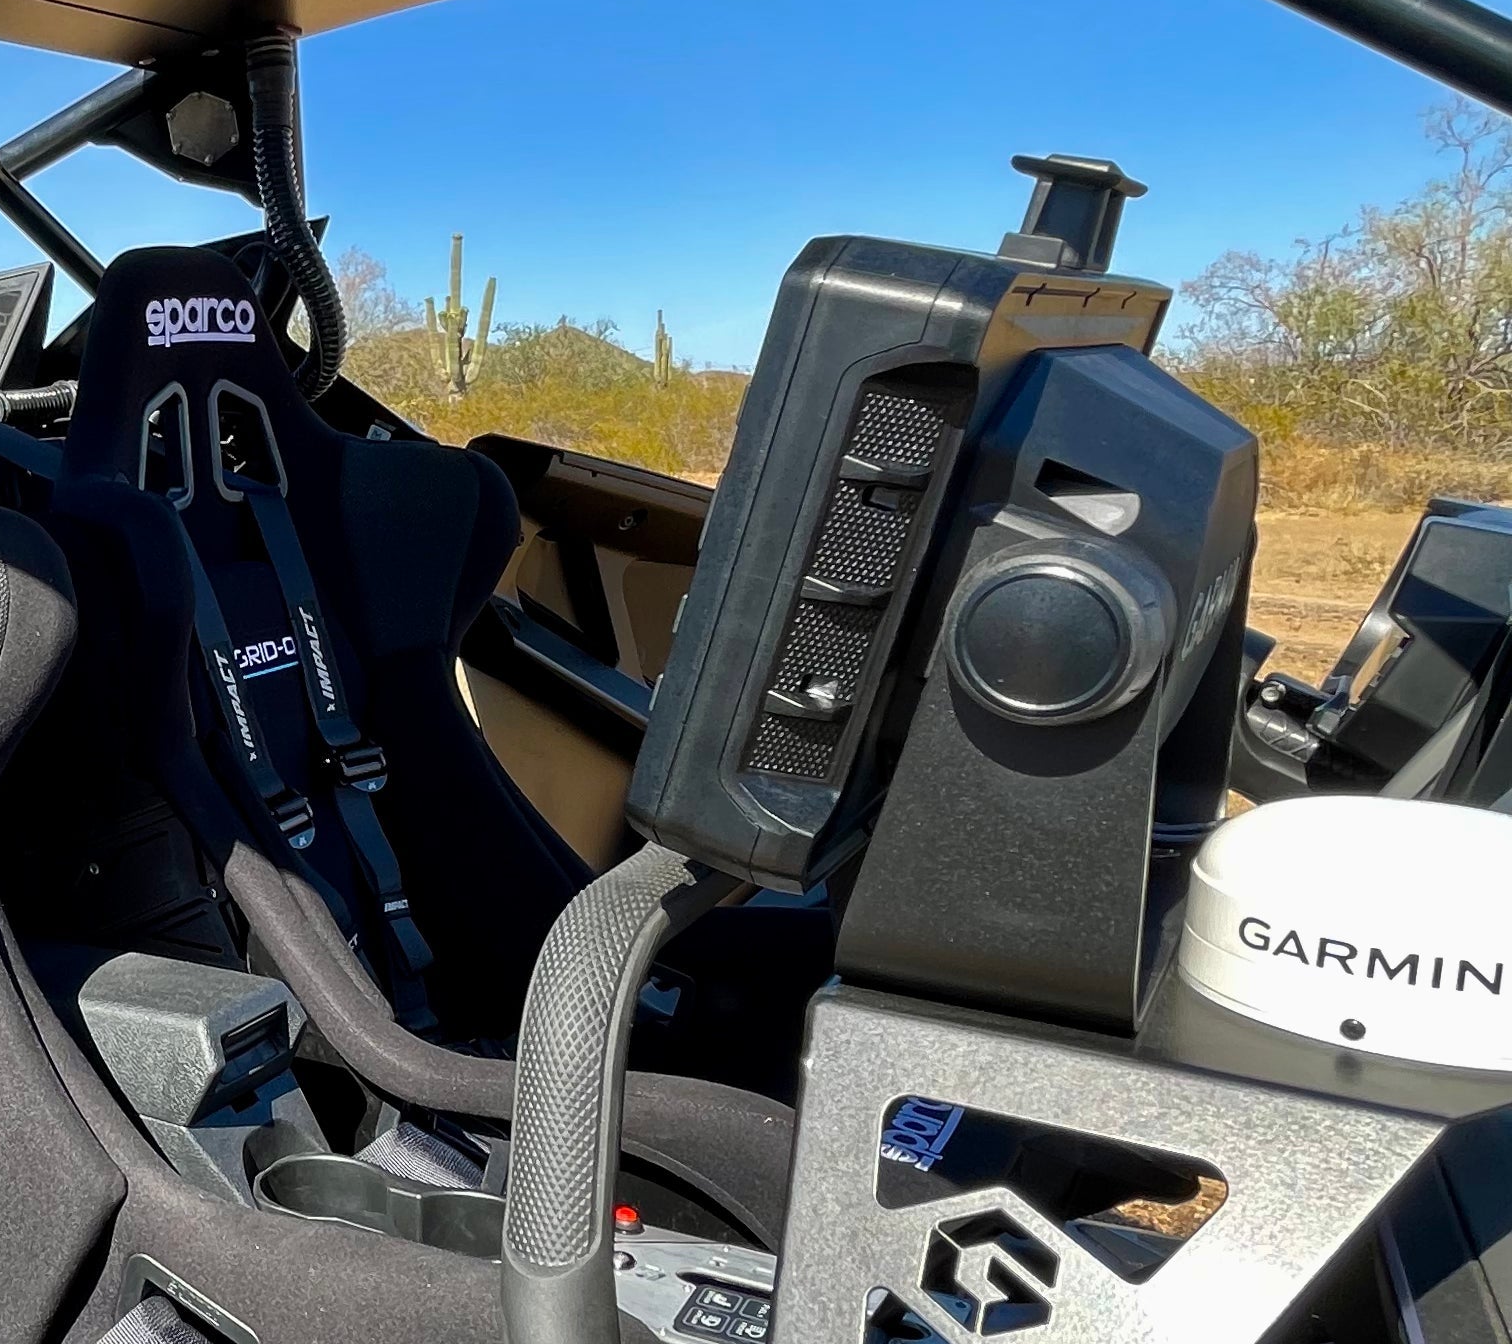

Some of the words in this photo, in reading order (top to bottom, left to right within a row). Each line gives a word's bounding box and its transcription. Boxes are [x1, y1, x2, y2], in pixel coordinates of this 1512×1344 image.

[145, 297, 256, 348] sparco
[298, 605, 336, 700] IMPACT
[213, 649, 255, 749] IMPACT
[1238, 916, 1504, 996] GARMIN
